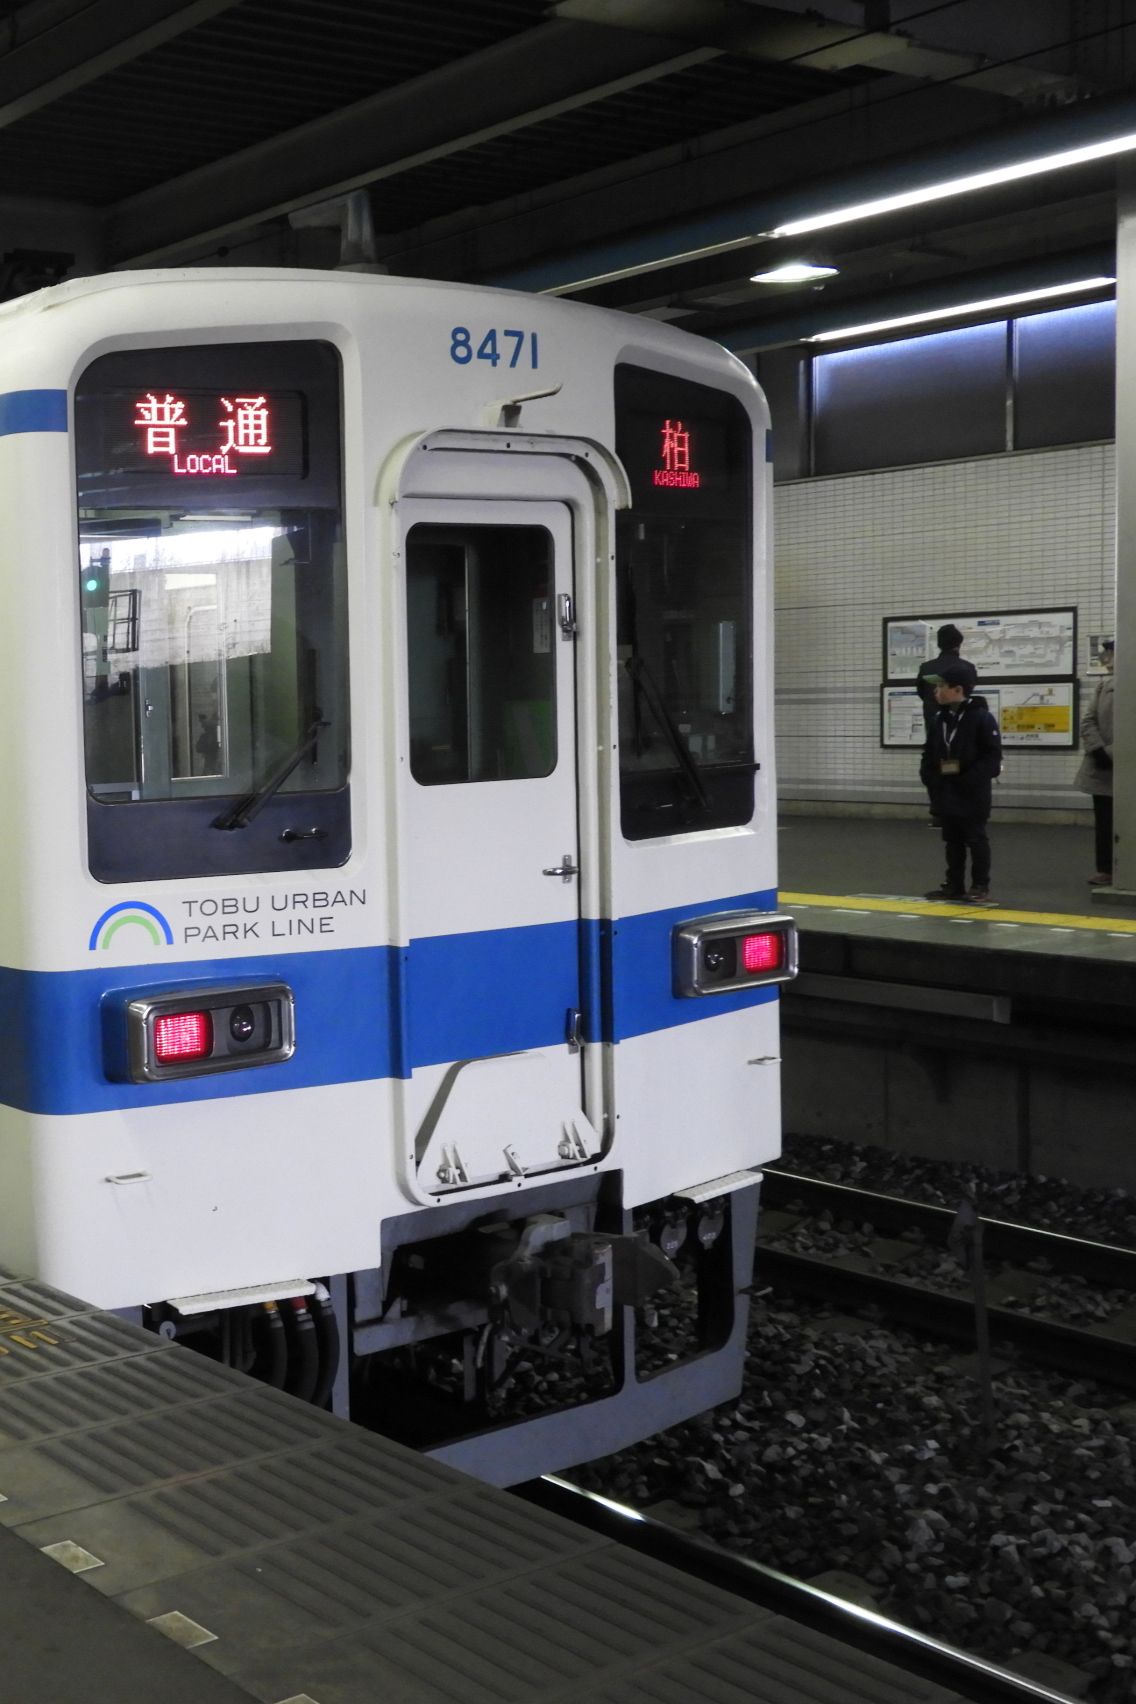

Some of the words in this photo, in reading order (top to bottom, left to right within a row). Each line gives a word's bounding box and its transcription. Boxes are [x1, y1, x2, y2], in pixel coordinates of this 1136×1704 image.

[450, 326, 538, 369] 8471
[134, 393, 272, 454] 普通
[661, 419, 690, 471] 柏
[174, 454, 237, 474] LOCAL
[653, 469, 700, 488] KASHIWA
[182, 895, 260, 917] TOBU
[271, 888, 366, 911] URBAN
[184, 921, 260, 944] PARK
[271, 916, 335, 937] LINE
